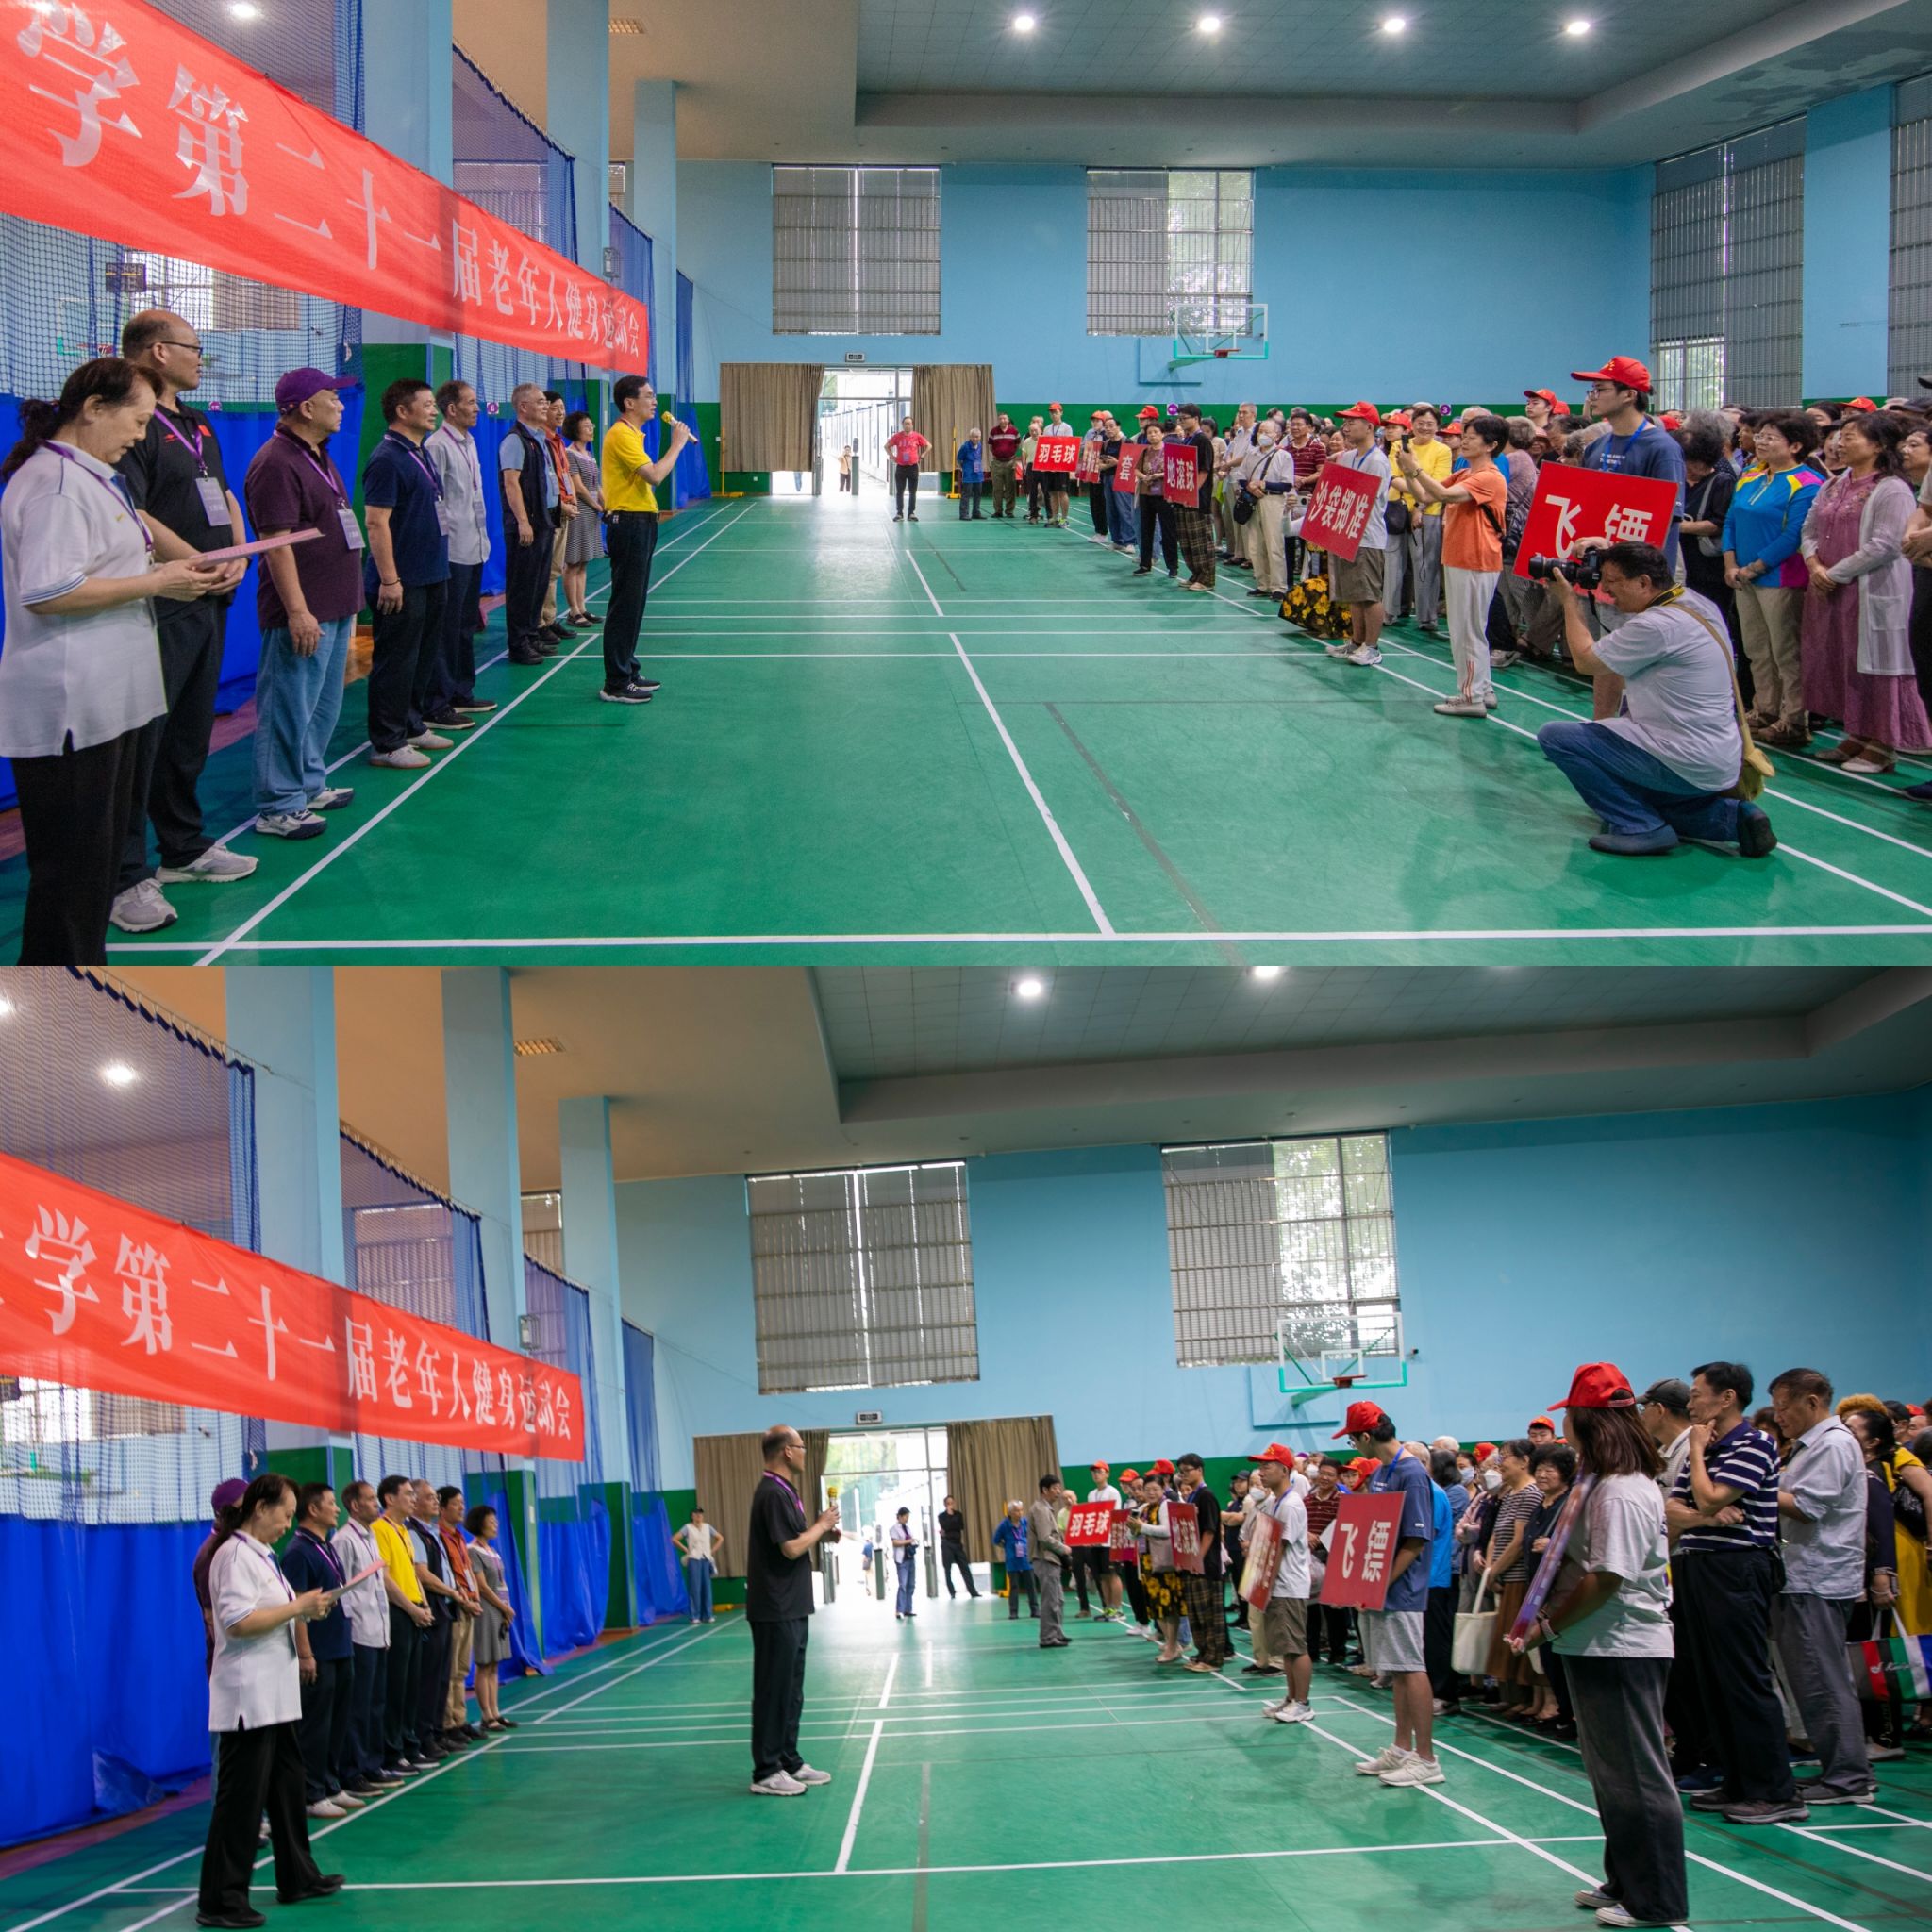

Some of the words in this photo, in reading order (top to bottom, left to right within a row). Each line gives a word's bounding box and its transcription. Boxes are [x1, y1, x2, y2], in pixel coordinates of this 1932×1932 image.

[1038, 443, 1076, 464] 羽毛球
[1119, 455, 1136, 481] 套
[1166, 455, 1195, 492] 地滚球
[1307, 480, 1369, 540] 沙袋掷准
[0, 1203, 572, 1441] 学第二十一届老年人健身运动会
[1069, 1510, 1111, 1538] 羽毛球
[1340, 1520, 1392, 1583] 飞镖
